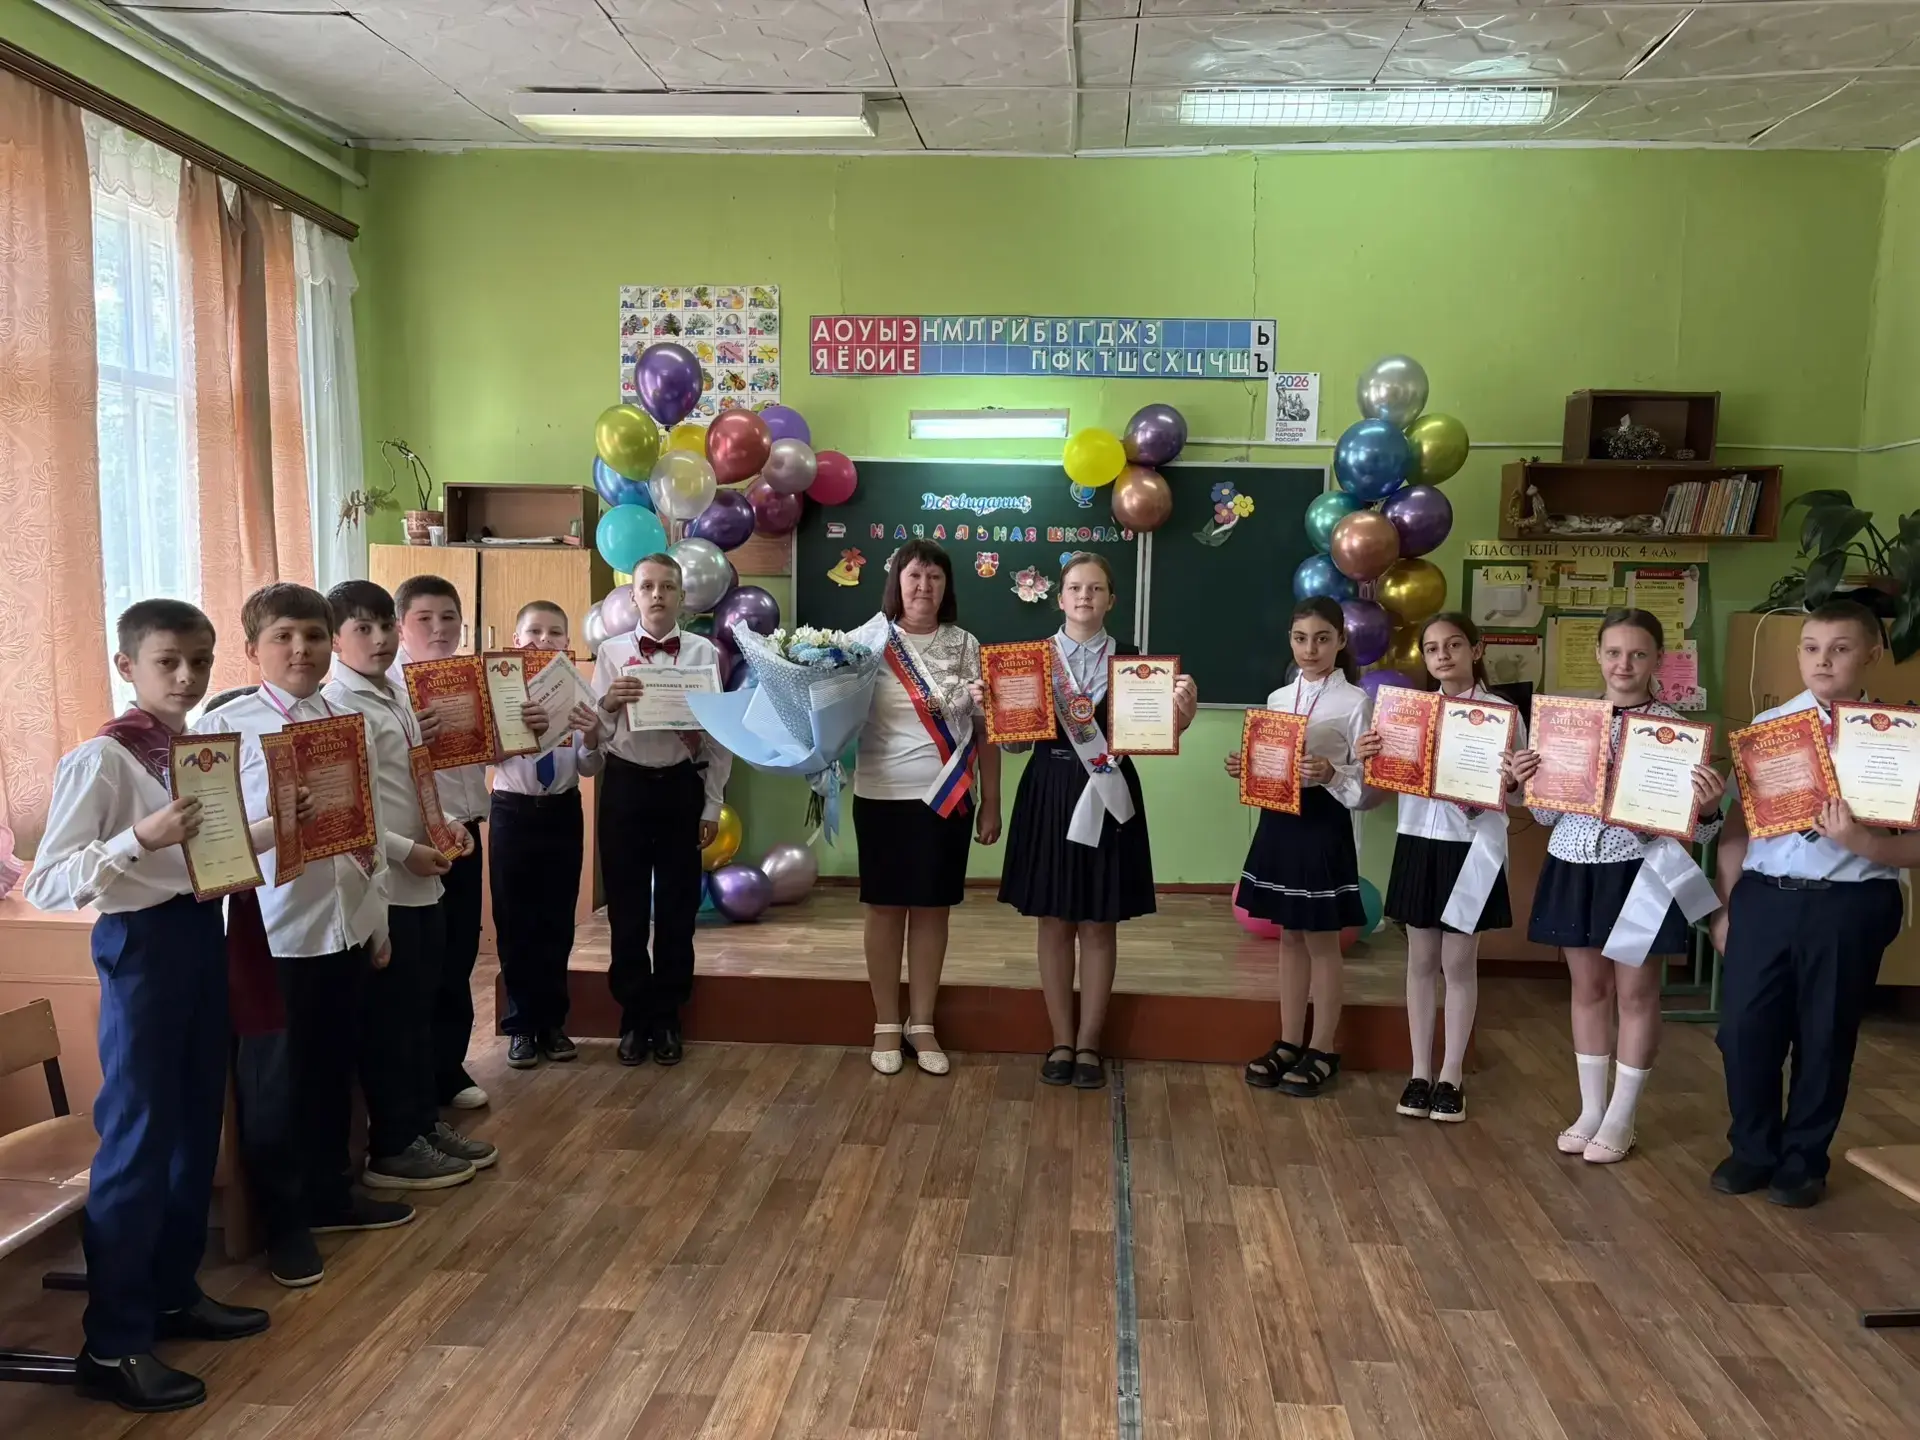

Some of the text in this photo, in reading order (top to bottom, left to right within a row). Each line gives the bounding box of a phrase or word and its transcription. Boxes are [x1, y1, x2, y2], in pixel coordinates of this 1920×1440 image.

[1278, 375, 1309, 388] 2026
[1469, 541, 1559, 556] КЛАССНЫЙ
[1571, 546, 1631, 558] УГОЛОК
[1640, 545, 1647, 557] 4
[1482, 568, 1489, 580] 4
[997, 659, 1035, 669] ДИПЛОМ
[427, 675, 468, 689] ДИПЛОМ
[1387, 706, 1422, 717] ДИПЛОМ
[1549, 717, 1593, 728] ДИПЛОМ
[1258, 728, 1290, 738] ДИПЛОМ
[1752, 731, 1801, 751] ДИПЛОМ
[305, 740, 349, 757] ДИПЛОМ
